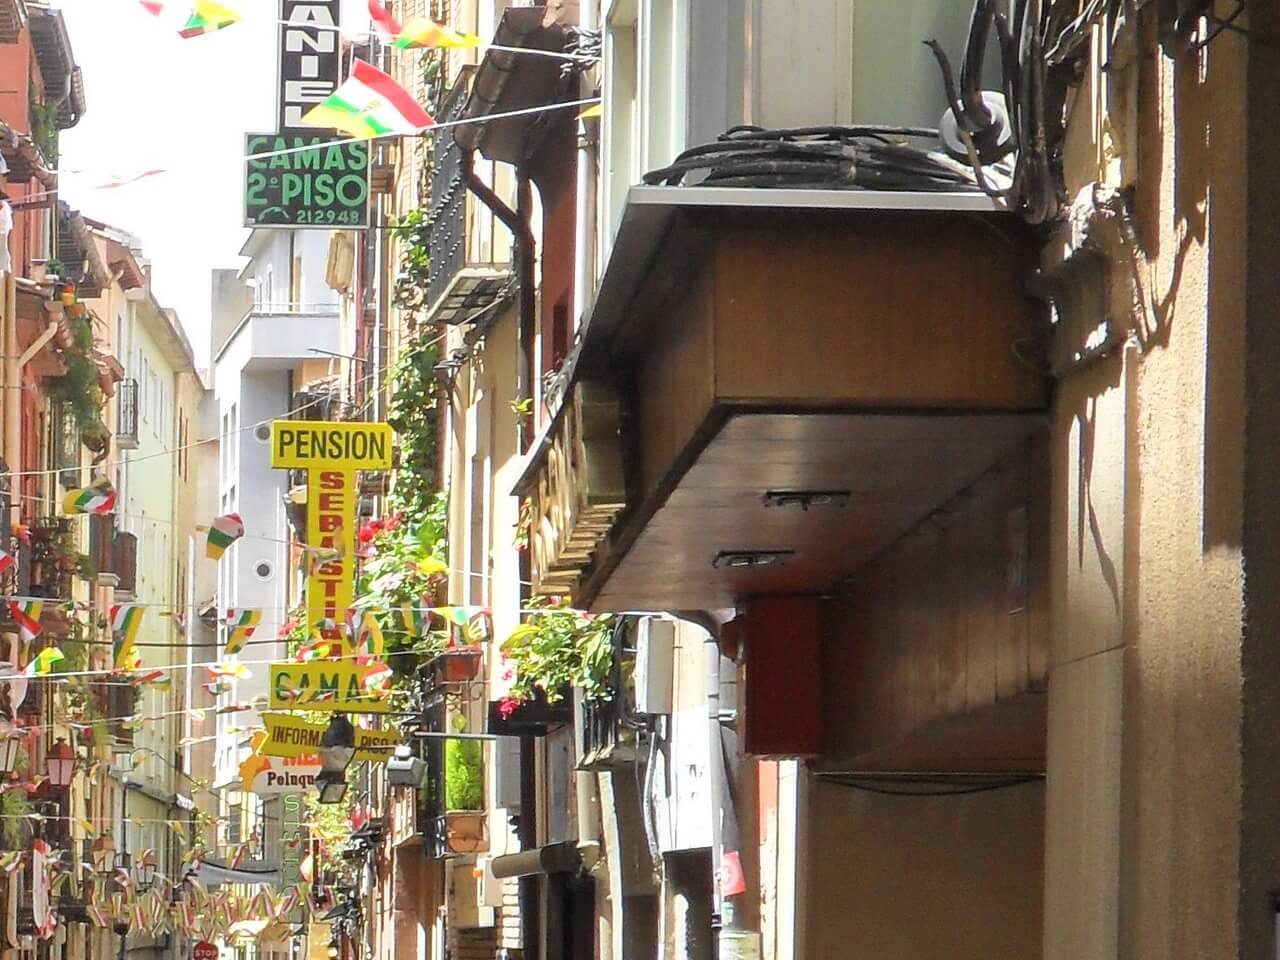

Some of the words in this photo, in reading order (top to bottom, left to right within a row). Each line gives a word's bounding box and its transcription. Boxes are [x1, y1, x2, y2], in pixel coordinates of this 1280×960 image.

[284, 0, 336, 128] ANIEL
[247, 137, 367, 170] CAMAS
[282, 174, 368, 207] PISO
[297, 210, 360, 224] 212948
[279, 430, 385, 460] PENSION
[276, 671, 384, 703] CAMA
[272, 726, 326, 748] INFORM
[267, 772, 317, 788] Peluqu
